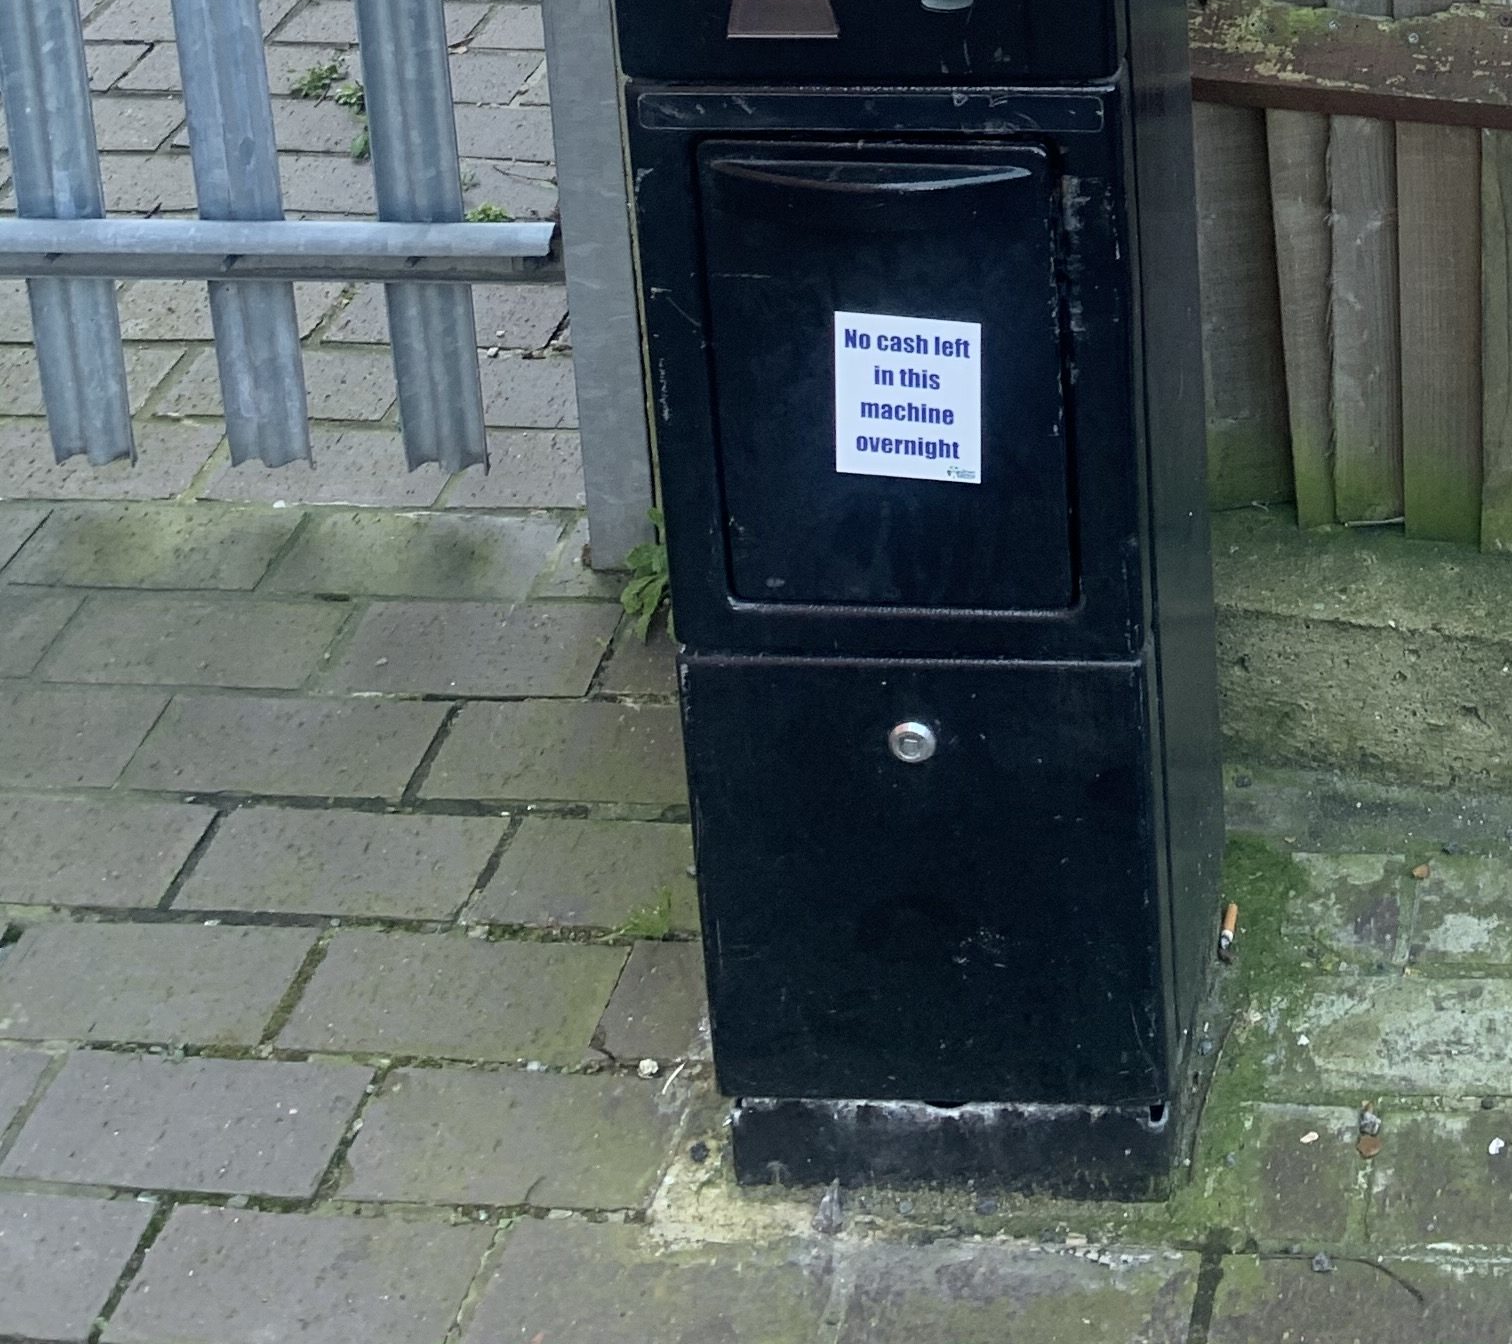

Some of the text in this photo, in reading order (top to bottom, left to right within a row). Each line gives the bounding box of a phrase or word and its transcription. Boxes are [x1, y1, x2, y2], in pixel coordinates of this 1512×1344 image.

[844, 328, 971, 359] No cash left
[874, 365, 941, 391] in this
[860, 401, 955, 426] machine
[855, 435, 960, 460] overnight
